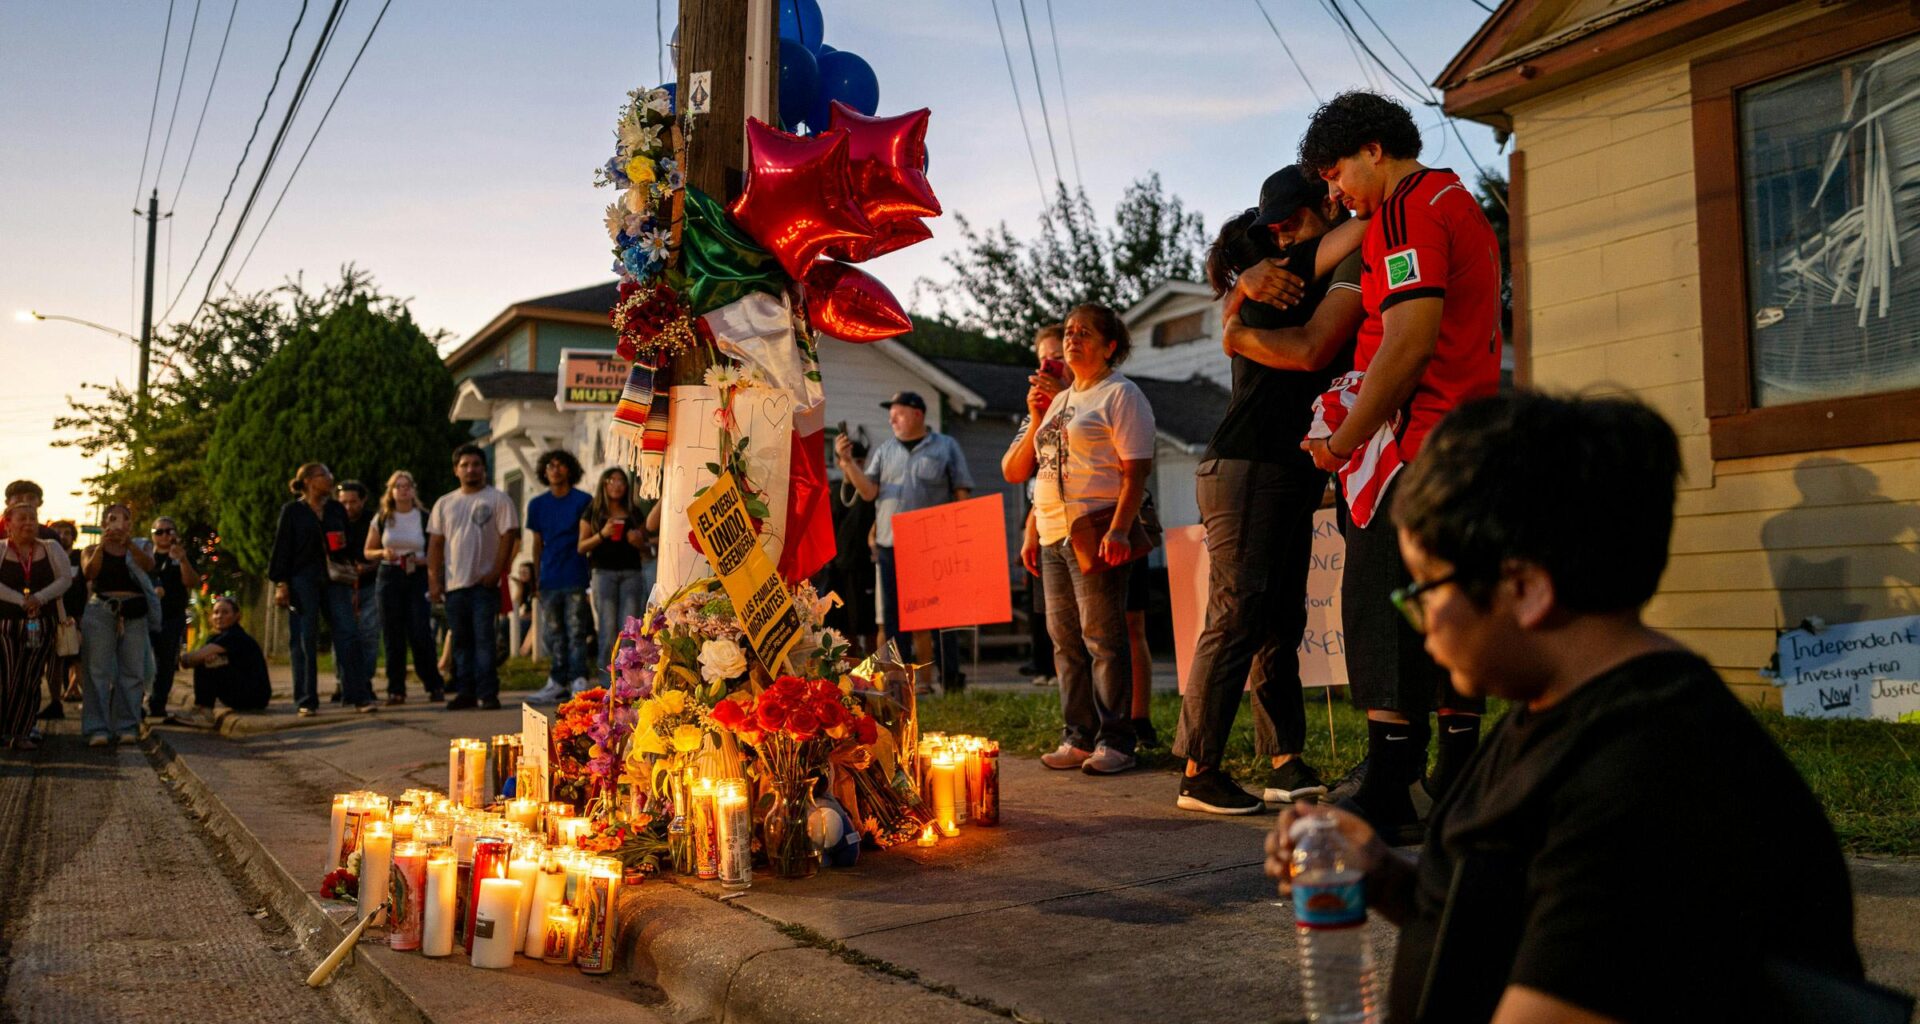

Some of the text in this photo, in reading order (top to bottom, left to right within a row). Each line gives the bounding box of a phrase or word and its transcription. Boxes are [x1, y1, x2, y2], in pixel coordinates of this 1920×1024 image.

[597, 361, 626, 373] The
[570, 389, 619, 402] MUST
[709, 486, 739, 523] PUEBLO
[707, 507, 747, 558] UNIDO
[743, 599, 756, 621] LAS
[752, 572, 780, 608] FAMILIAS
[747, 586, 788, 641] MIGRANTES!
[1788, 627, 1918, 661] Independent
[1794, 660, 1900, 685] Investigation
